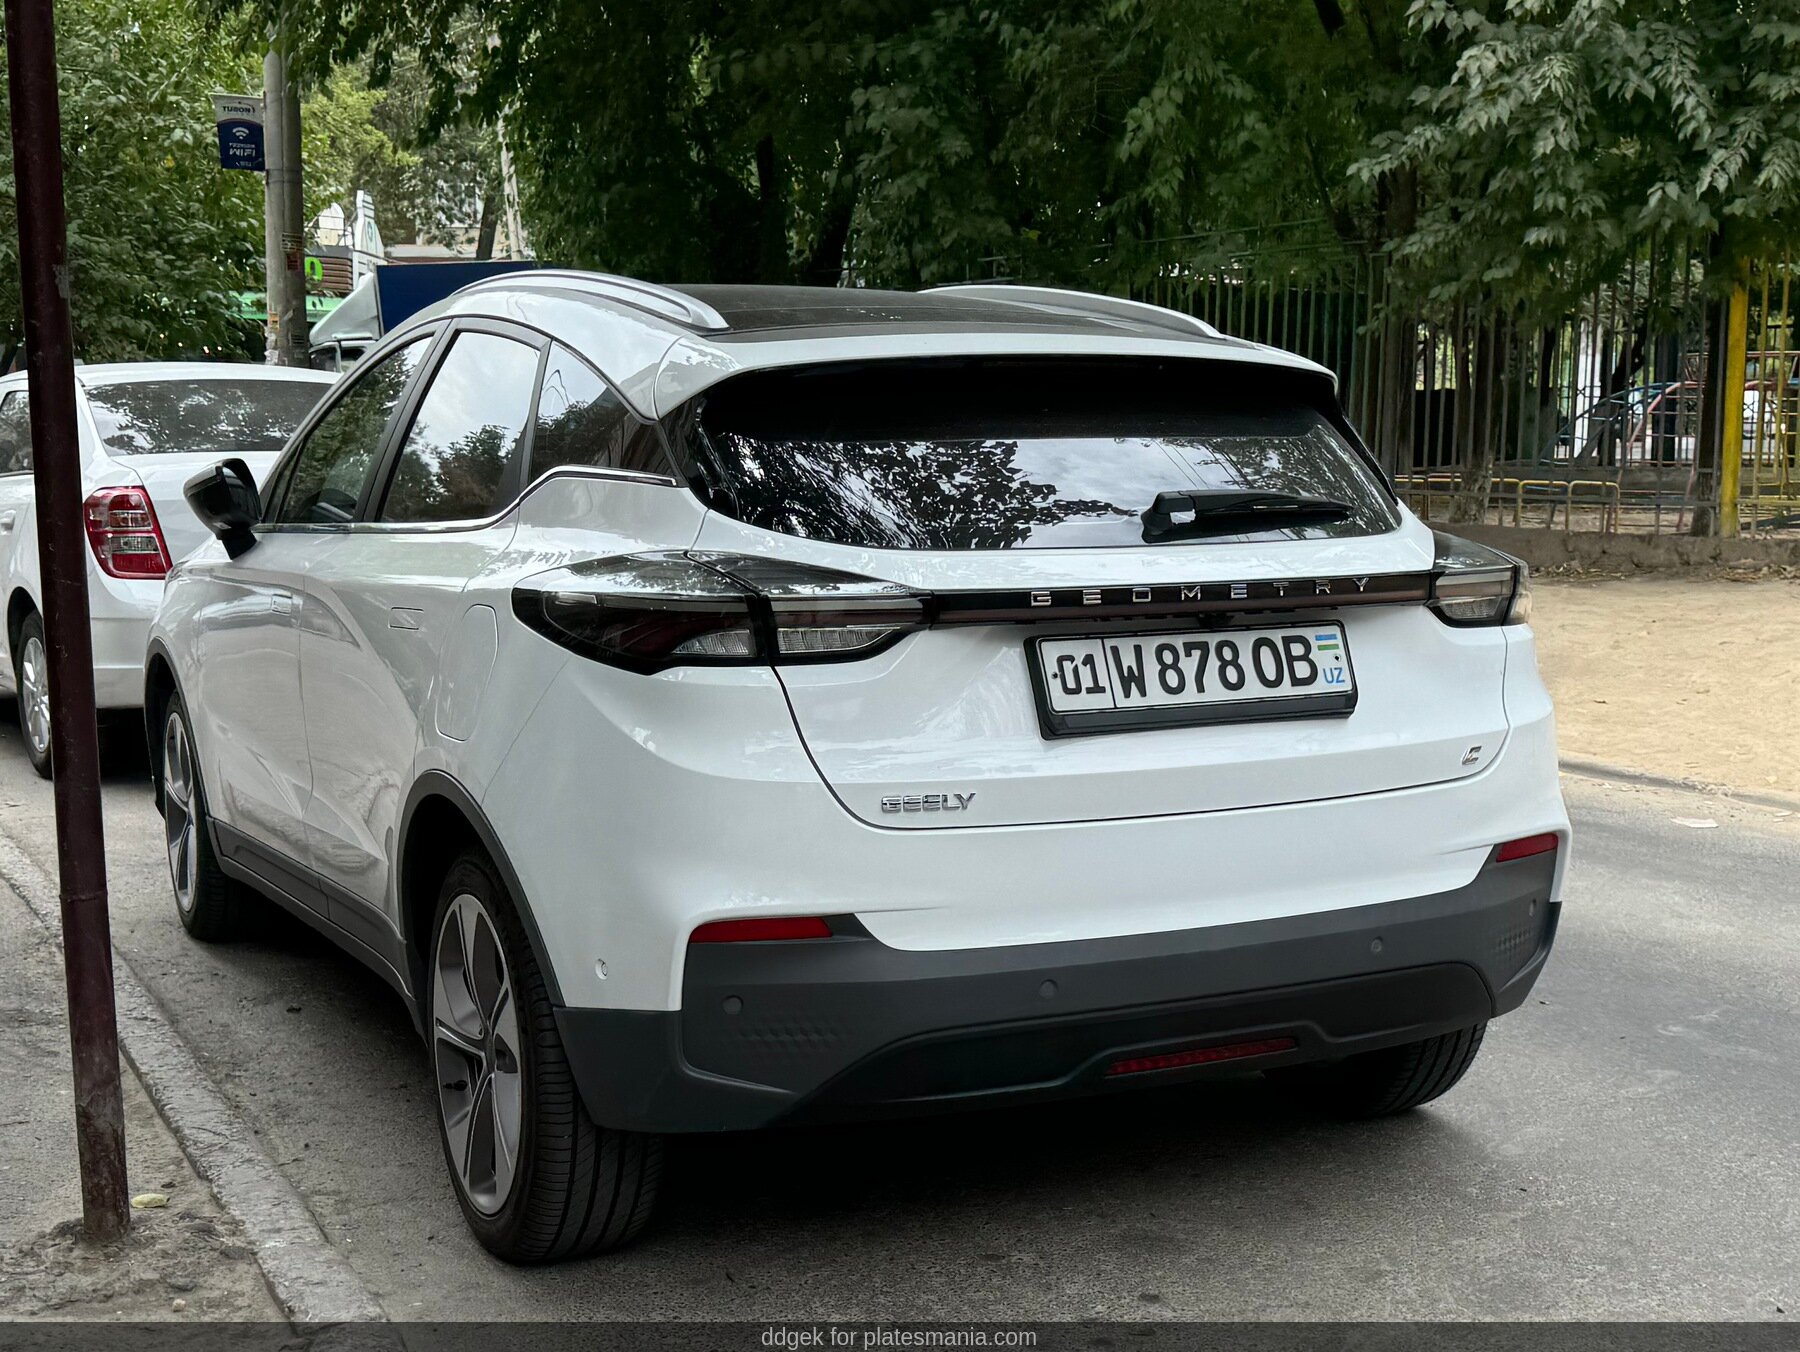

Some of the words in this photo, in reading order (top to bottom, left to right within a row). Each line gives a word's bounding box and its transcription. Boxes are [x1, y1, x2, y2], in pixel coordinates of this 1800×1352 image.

[1031, 577, 1370, 607] GEOMETRY
[1056, 653, 1107, 696] 01
[1323, 667, 1346, 685] UZ
[881, 792, 977, 814] GEELY
